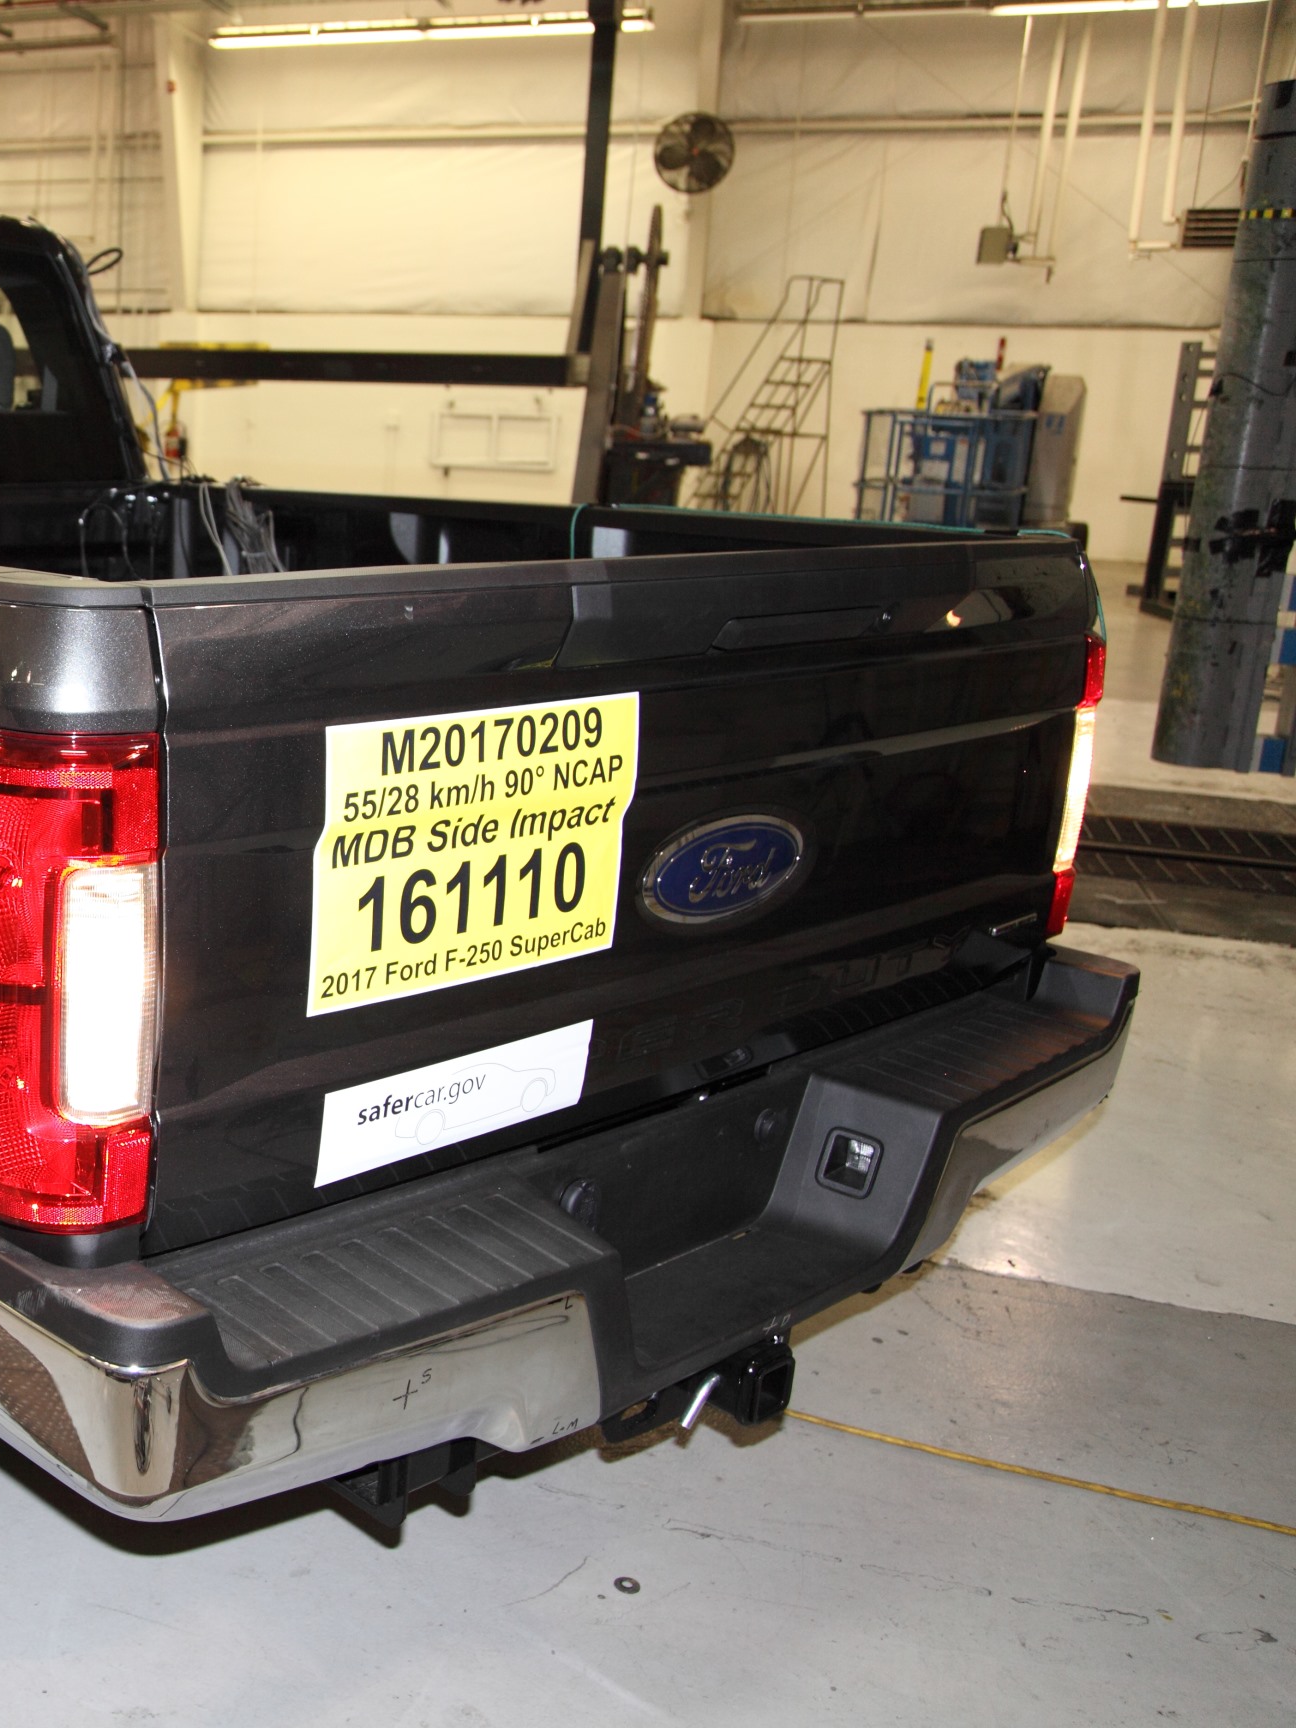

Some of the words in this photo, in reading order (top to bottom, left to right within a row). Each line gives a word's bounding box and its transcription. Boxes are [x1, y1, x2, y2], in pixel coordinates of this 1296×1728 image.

[381, 706, 603, 776] M20170209
[343, 784, 419, 823] 55/28
[429, 774, 495, 810] km/h
[553, 754, 623, 791] NCAP
[332, 824, 417, 869] MDB
[427, 814, 499, 853] Side
[510, 796, 616, 842] Impact
[358, 841, 586, 952] 161110
[688, 837, 774, 904] Ford
[321, 966, 377, 999] 2017
[385, 953, 437, 985] Ford
[445, 939, 503, 972] F-250
[510, 917, 606, 957] SuperCab
[357, 1074, 486, 1126] safercar.gov
